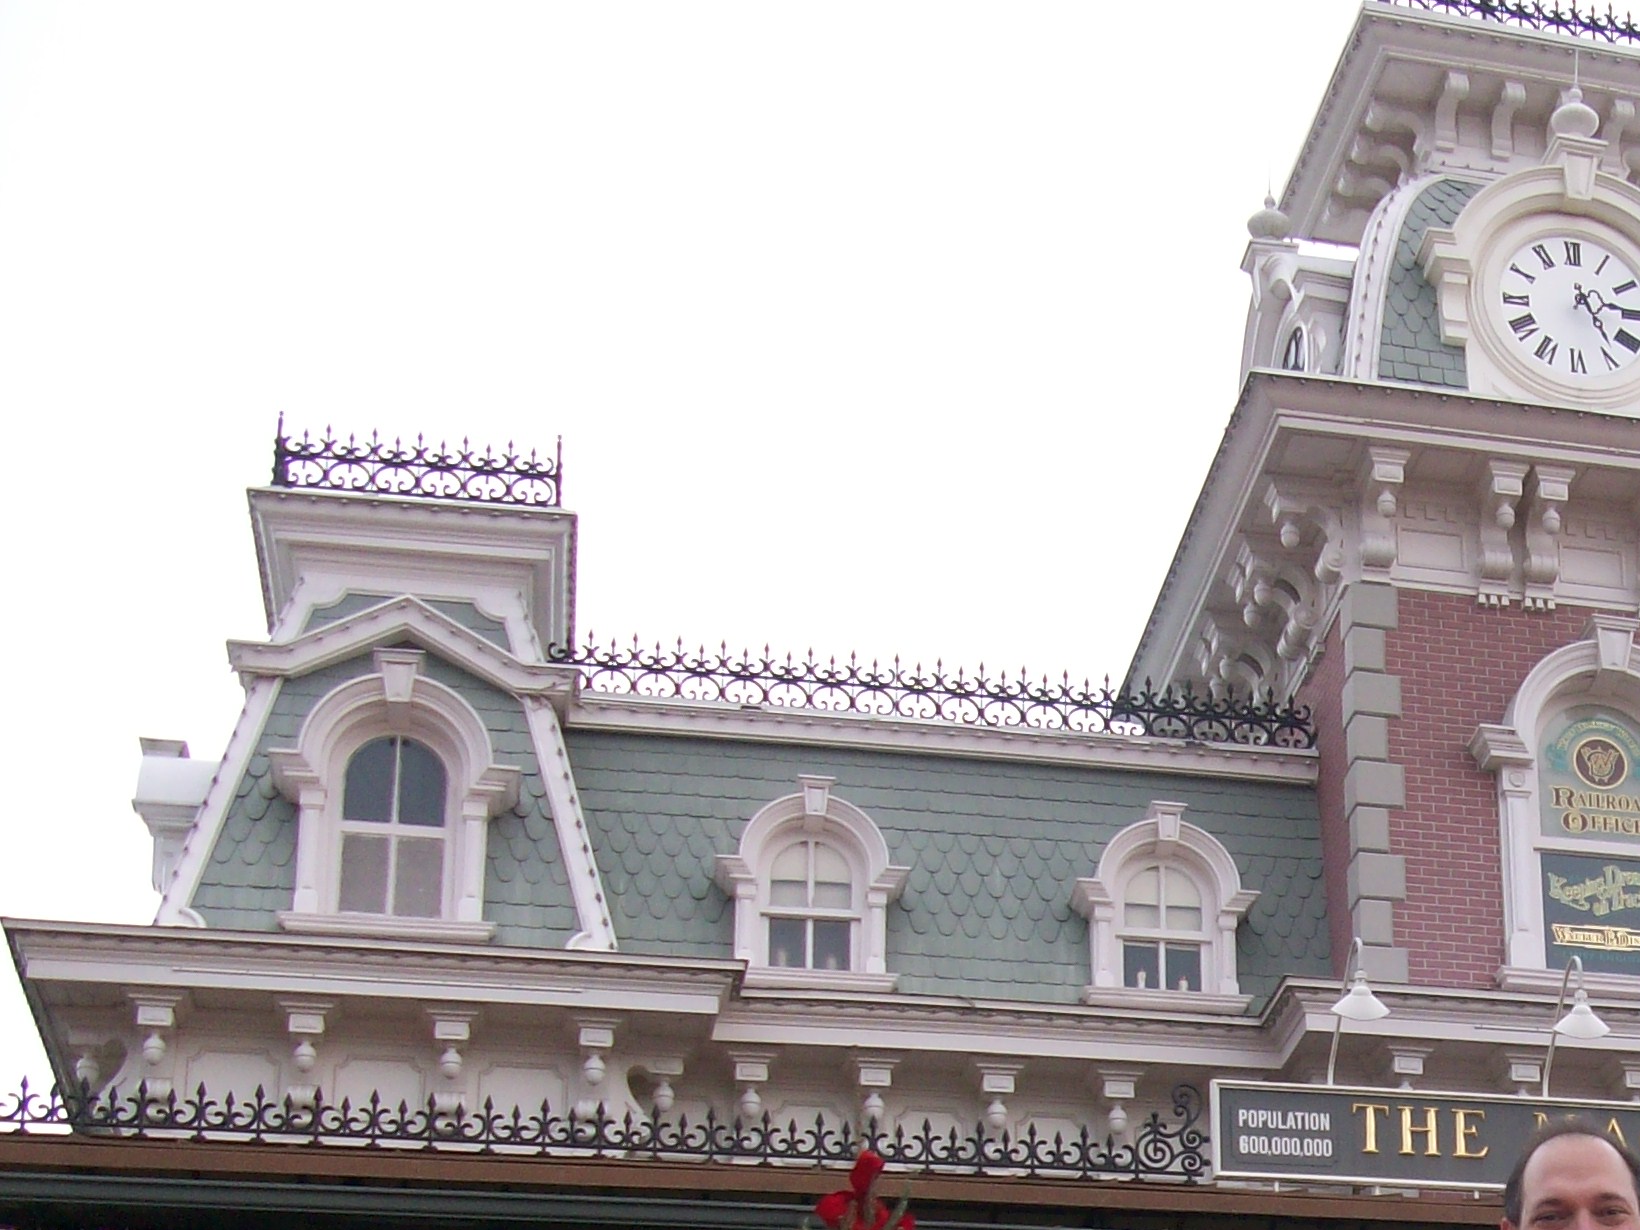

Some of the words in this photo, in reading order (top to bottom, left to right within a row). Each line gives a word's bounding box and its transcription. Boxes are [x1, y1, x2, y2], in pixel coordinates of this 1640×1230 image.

[1564, 241, 1582, 266] XII
[1238, 1108, 1331, 1132] POPULATION
[1352, 1102, 1489, 1159] THE
[1238, 1134, 1333, 1158] 600,000,000
